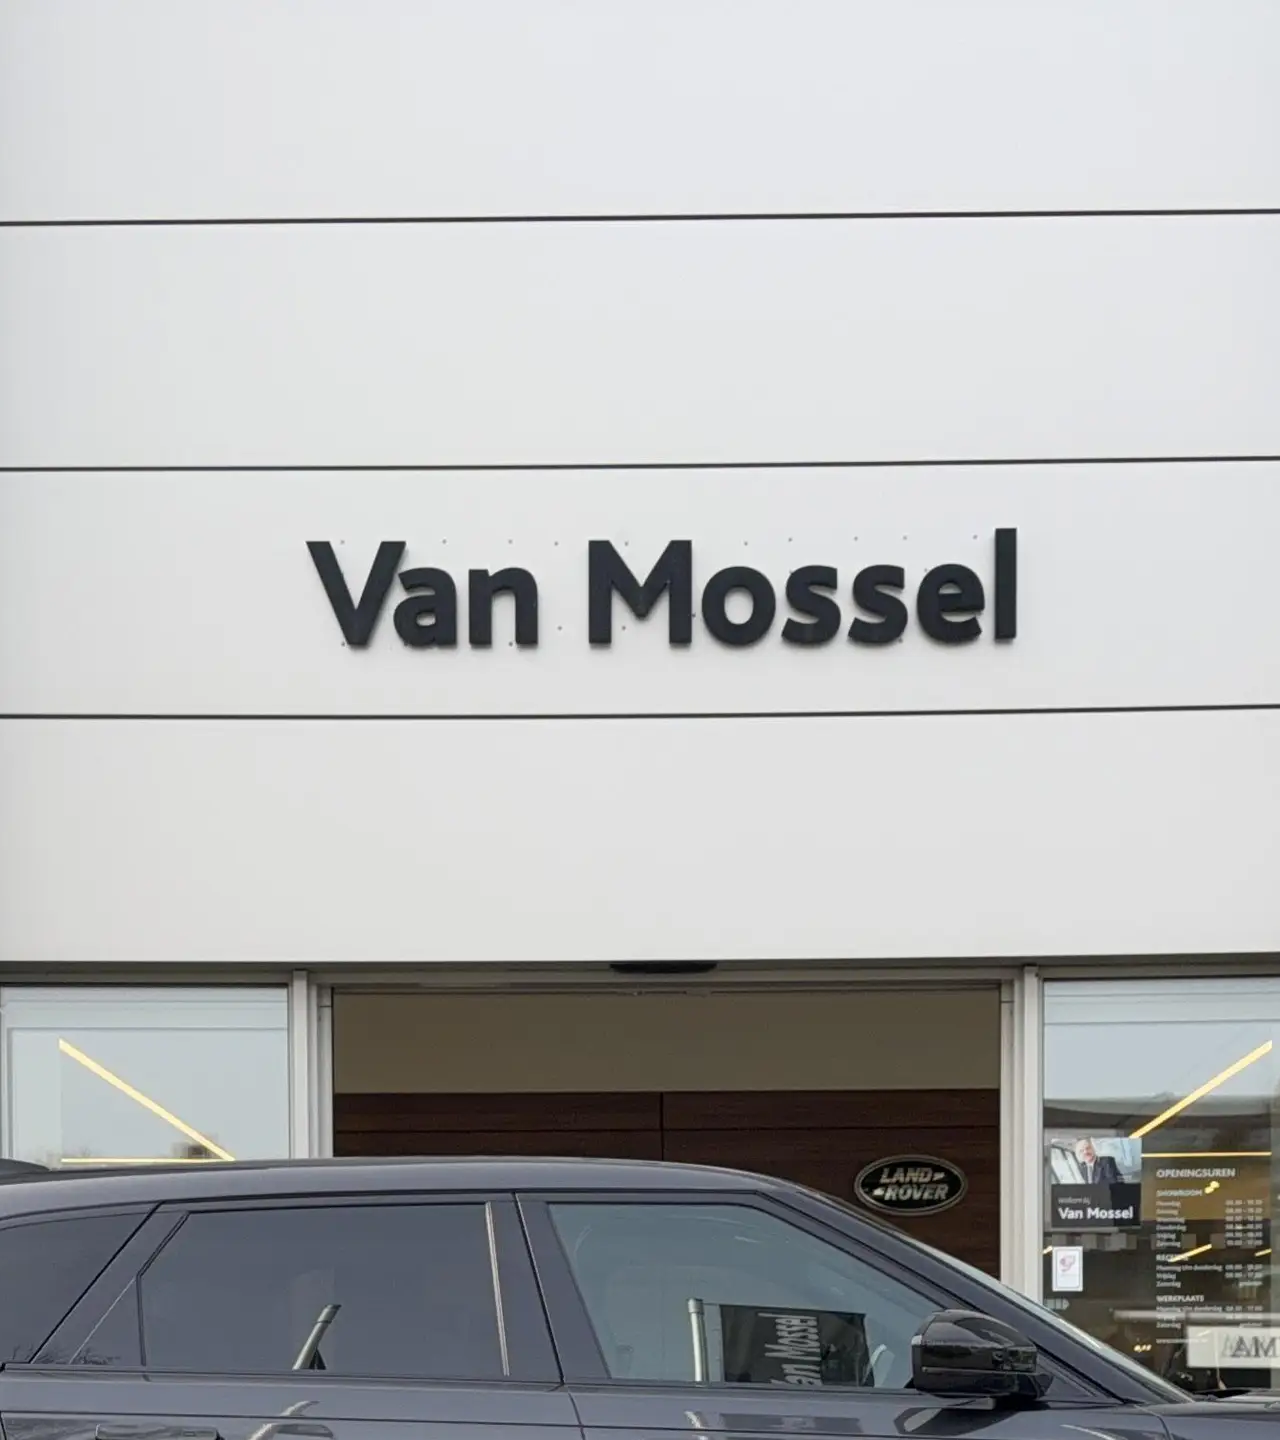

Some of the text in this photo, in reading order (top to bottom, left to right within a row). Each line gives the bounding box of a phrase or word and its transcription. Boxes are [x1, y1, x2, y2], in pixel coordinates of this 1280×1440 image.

[306, 528, 1017, 647] Van Mossel
[881, 1168, 933, 1183] LAND
[1156, 1168, 1236, 1178] OPENINGSUREN
[884, 1184, 949, 1200] ROVER
[1058, 1206, 1133, 1219] Van Mossel
[1156, 1295, 1205, 1303] WERKPLAATS
